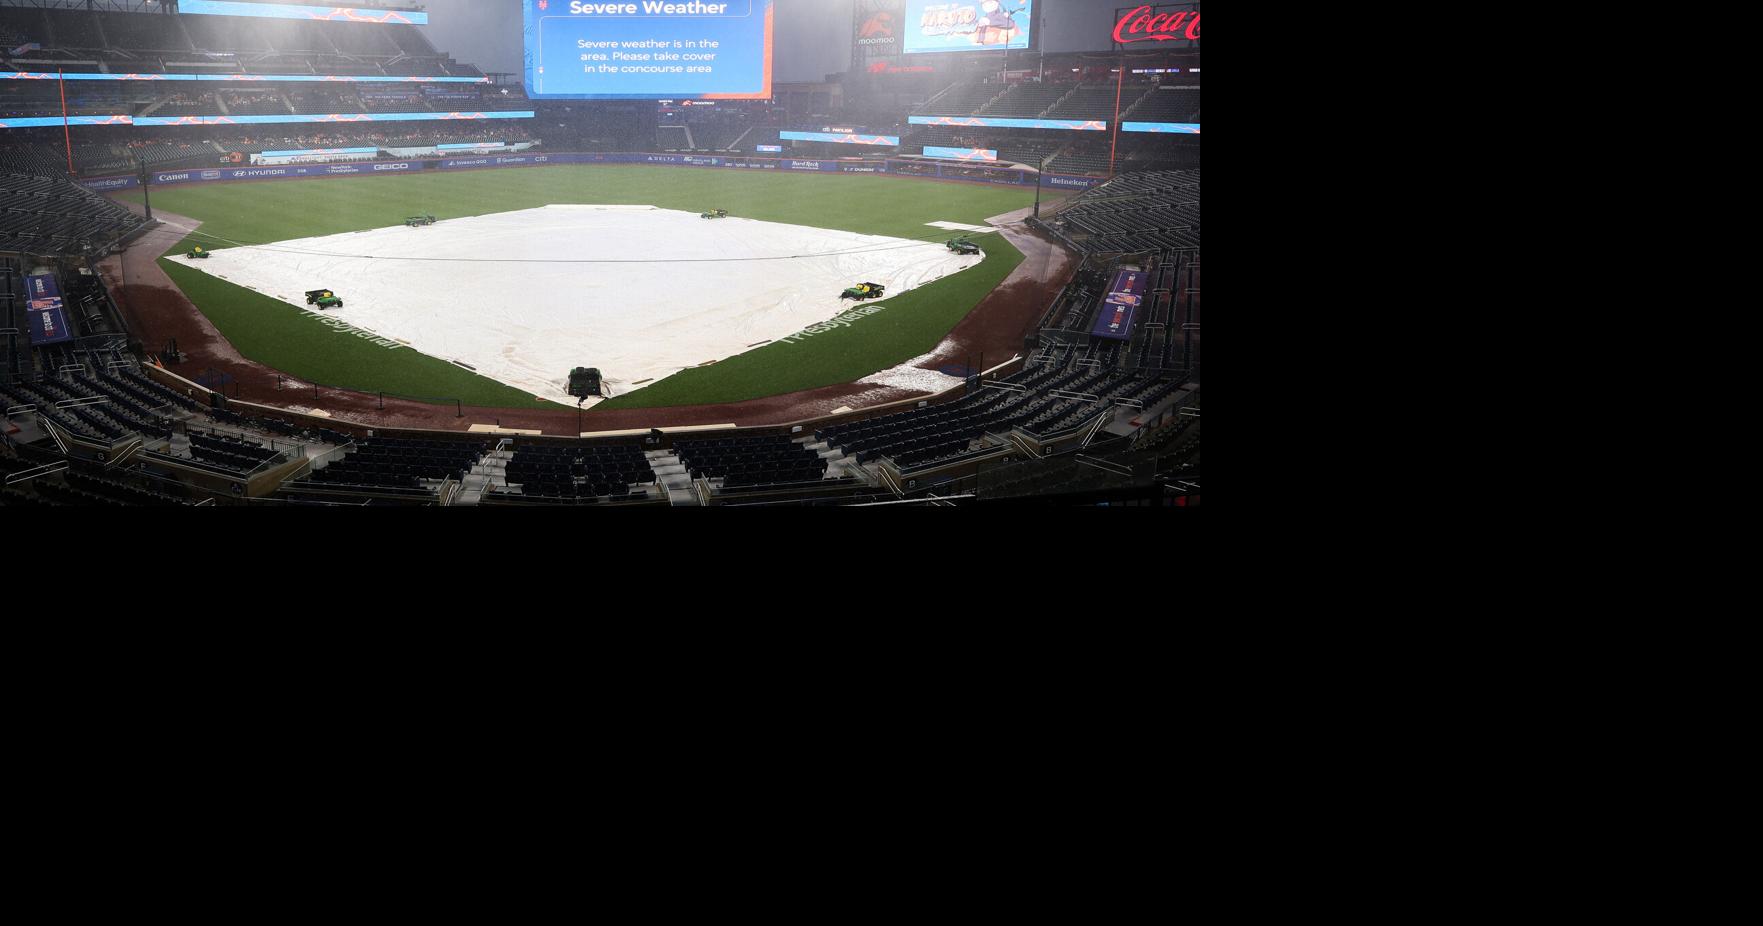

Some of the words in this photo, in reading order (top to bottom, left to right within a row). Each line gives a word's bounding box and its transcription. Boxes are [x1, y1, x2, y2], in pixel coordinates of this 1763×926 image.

[570, 1, 637, 14] Severe
[642, 0, 727, 14] Weather
[577, 39, 619, 48] Severe
[621, 39, 670, 48] weather
[673, 39, 682, 48] is
[685, 39, 696, 48] in
[699, 39, 719, 48] the
[858, 36, 895, 45] moomoo
[580, 52, 609, 61] area.
[612, 51, 651, 61] Please
[654, 51, 680, 61] take
[682, 53, 716, 61] cover
[584, 64, 596, 73] in
[598, 64, 618, 73] the
[621, 65, 684, 73] concourse
[686, 65, 712, 73] area
[373, 162, 409, 171] GEICO
[158, 173, 189, 182] Canon
[1050, 177, 1089, 186] Heineken
